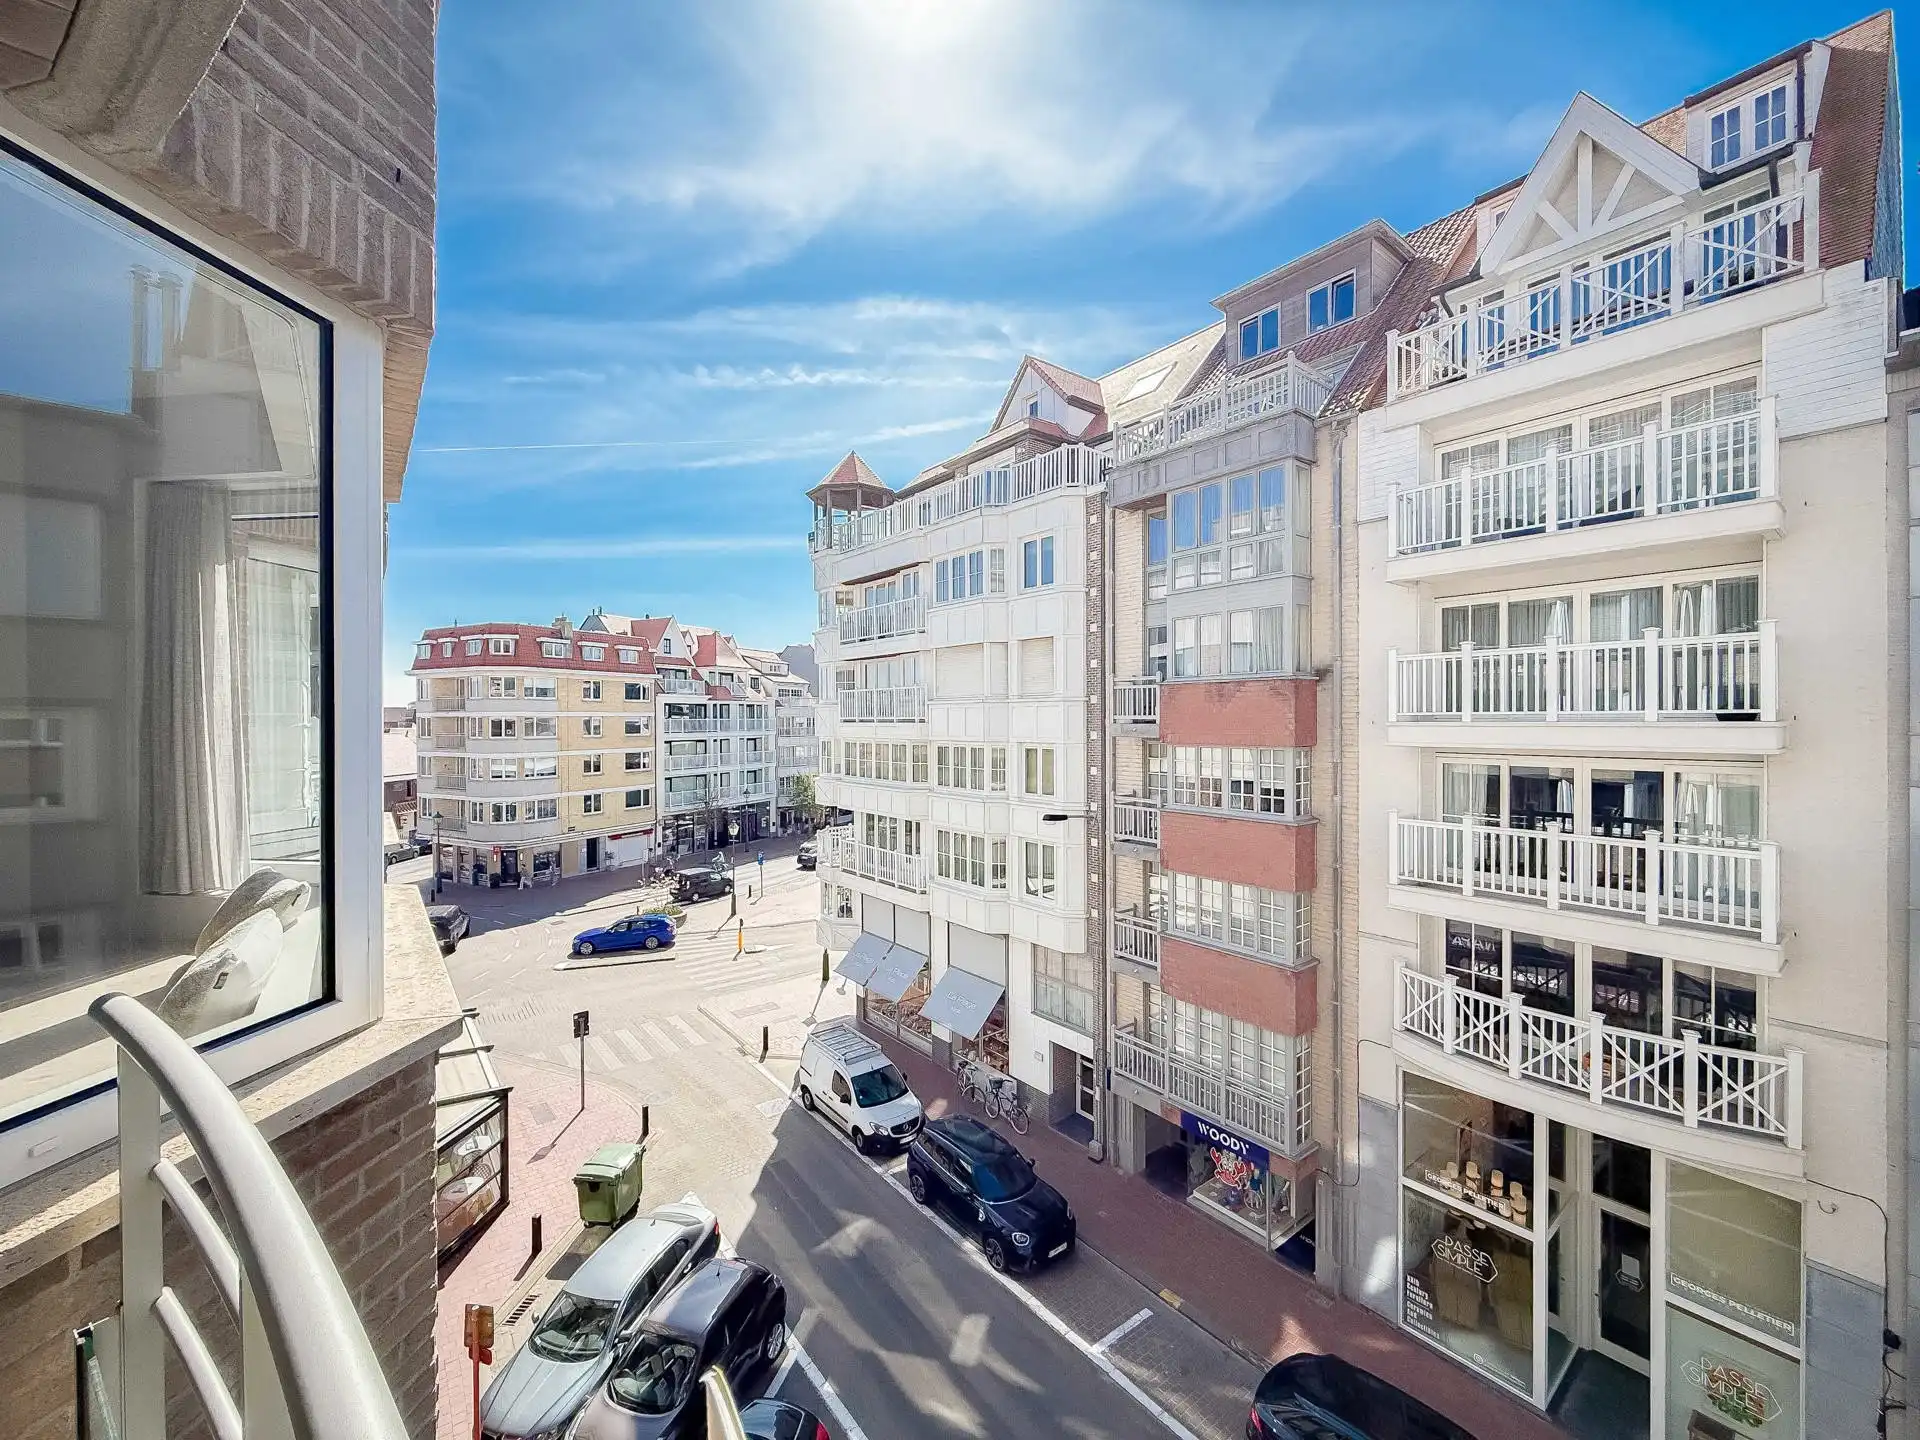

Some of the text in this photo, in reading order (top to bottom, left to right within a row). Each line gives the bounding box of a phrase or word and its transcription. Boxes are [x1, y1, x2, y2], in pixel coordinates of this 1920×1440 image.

[1198, 1121, 1249, 1155] WOODY
[1437, 1244, 1483, 1277] SIMPLE
[1444, 1235, 1489, 1267] PASSE
[1673, 1276, 1726, 1304] GEORGES
[1728, 1299, 1792, 1333] PELLETIER
[1688, 1367, 1759, 1413] SIMPLE
[1701, 1357, 1768, 1401] PASSE
